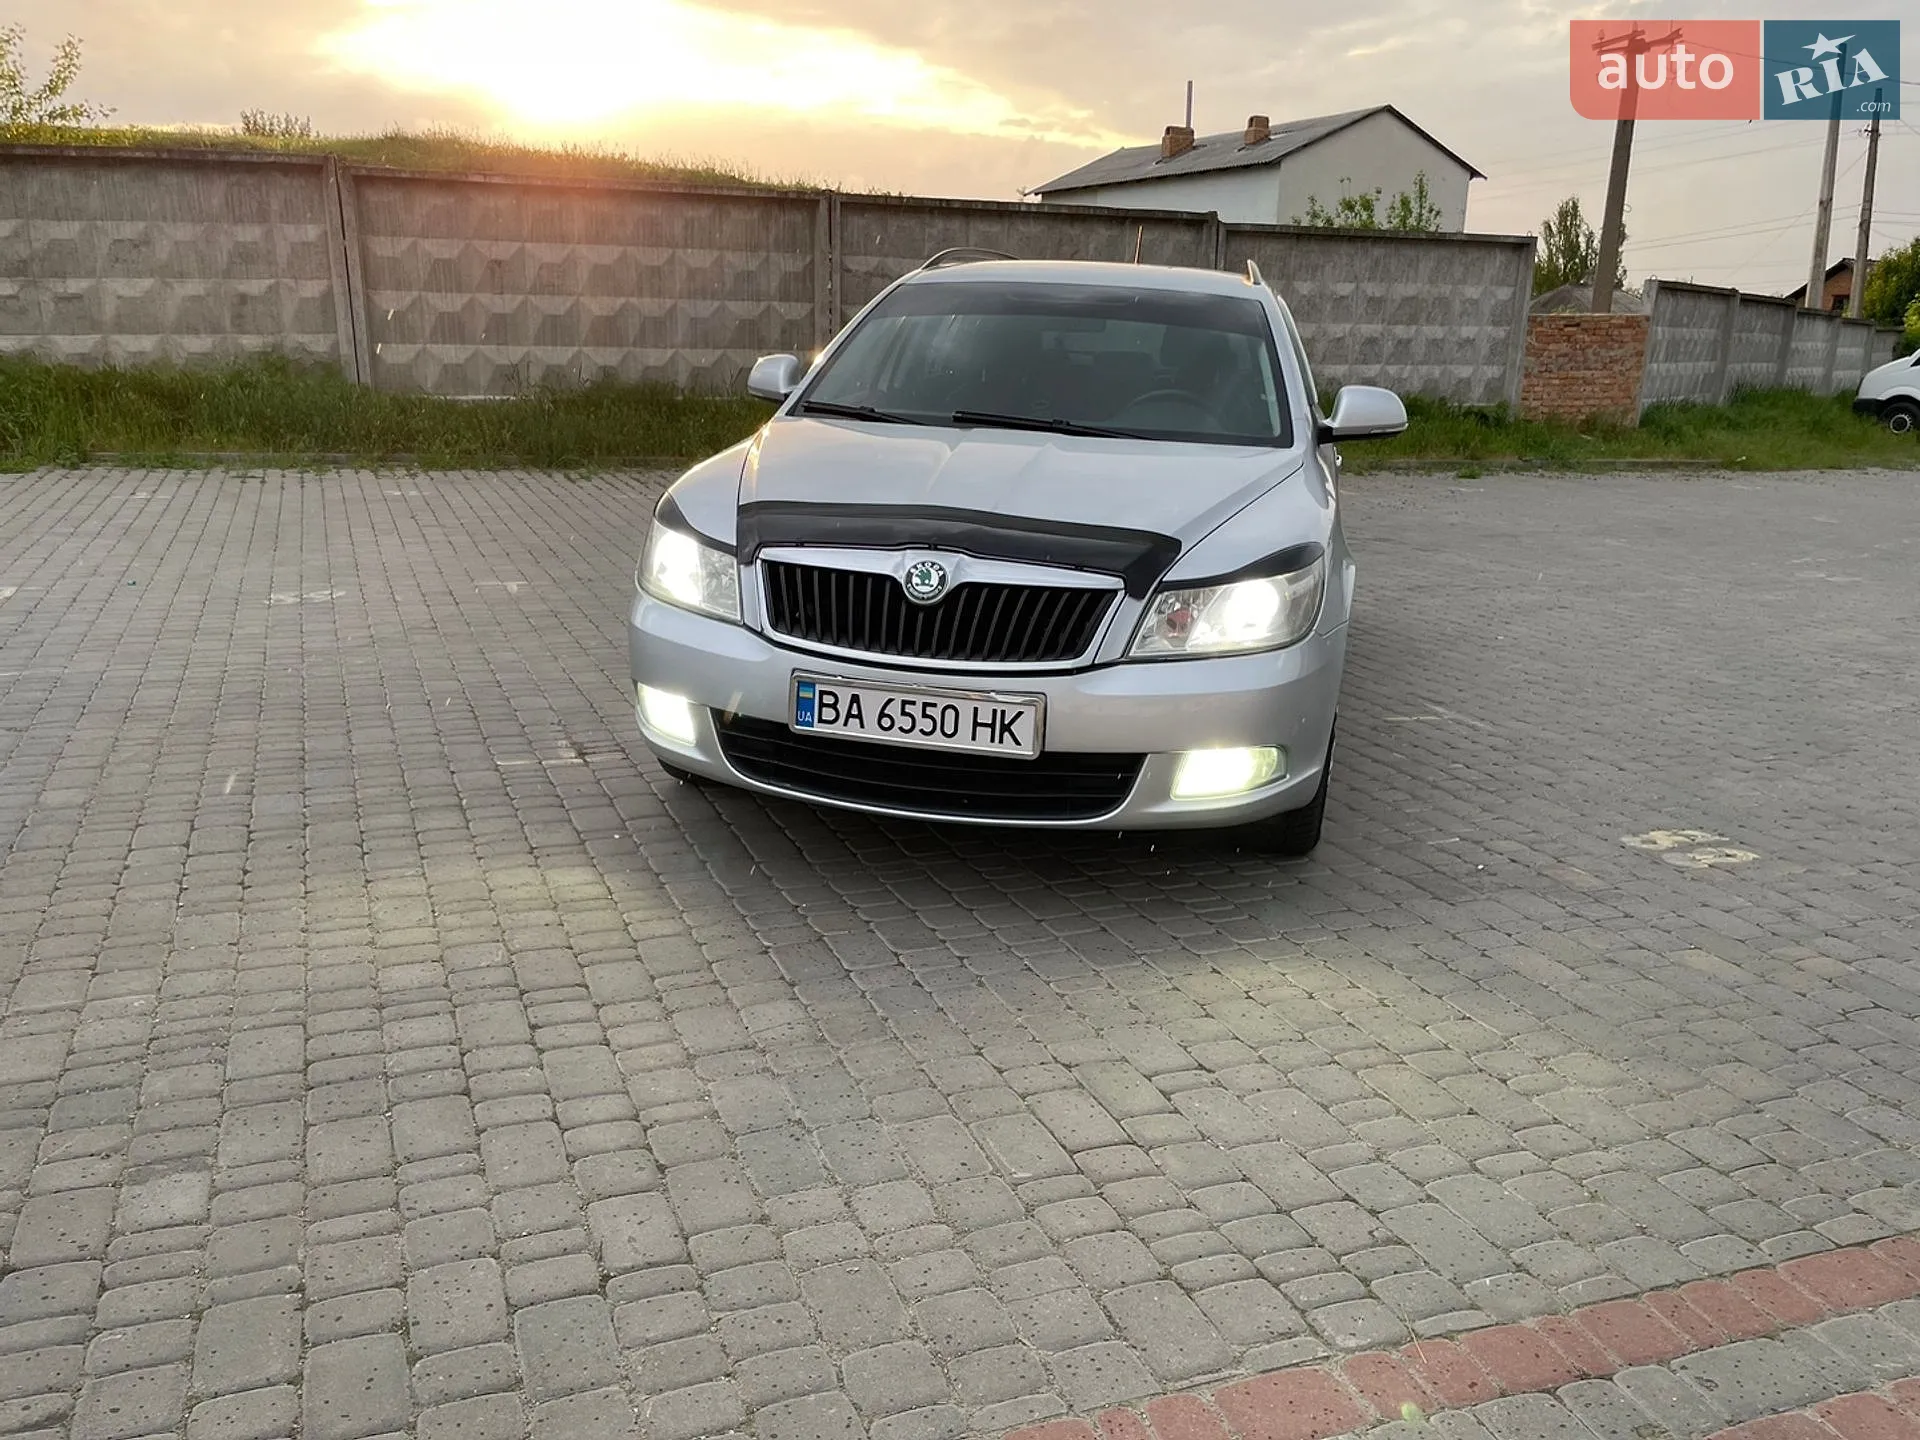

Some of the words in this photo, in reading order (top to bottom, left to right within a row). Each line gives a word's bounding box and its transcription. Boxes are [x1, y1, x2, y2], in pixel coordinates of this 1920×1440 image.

[797, 710, 813, 724] UA
[817, 689, 866, 730] BA
[876, 697, 960, 739] 6550
[970, 706, 1025, 747] HK
